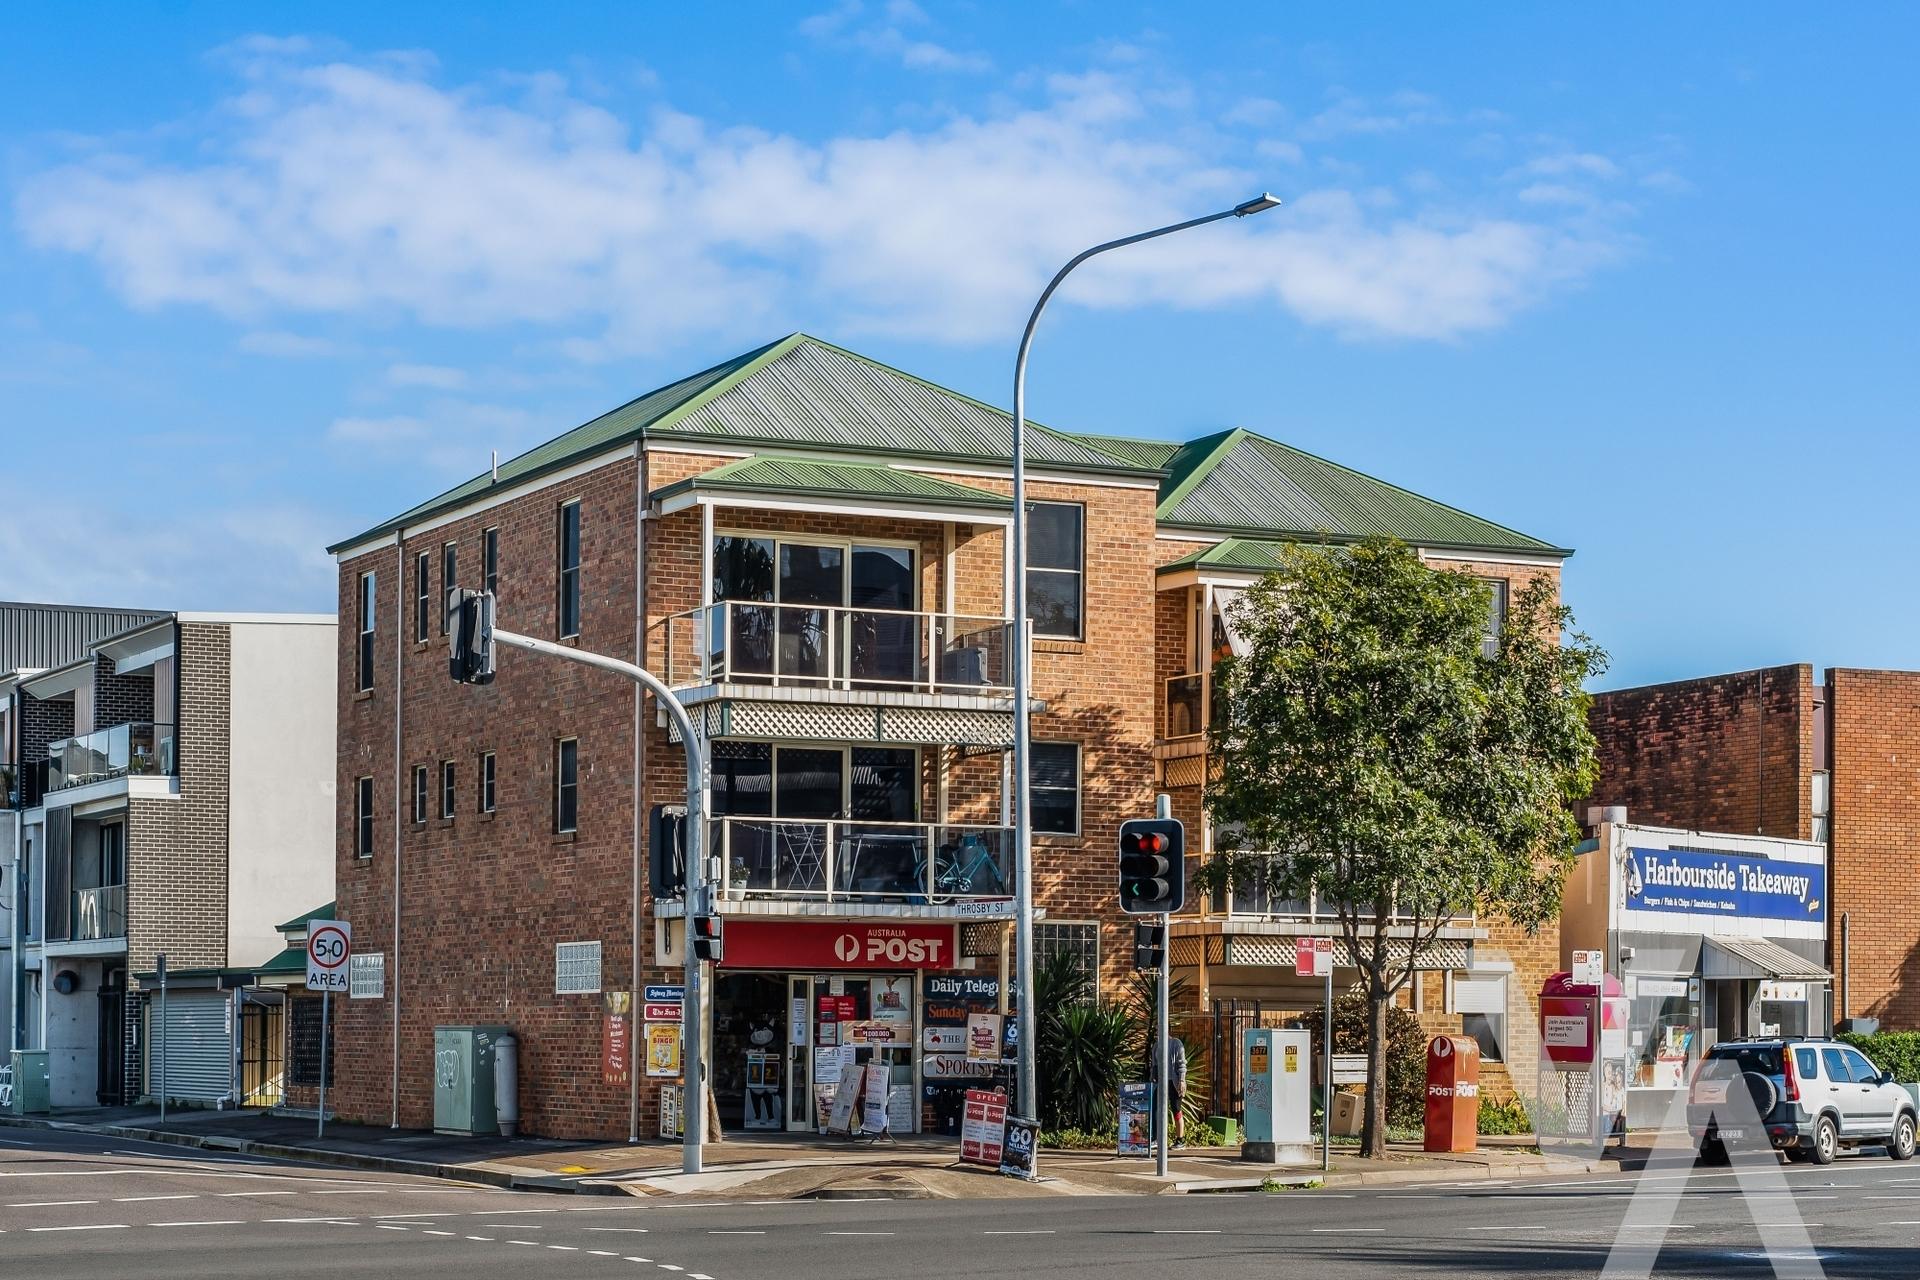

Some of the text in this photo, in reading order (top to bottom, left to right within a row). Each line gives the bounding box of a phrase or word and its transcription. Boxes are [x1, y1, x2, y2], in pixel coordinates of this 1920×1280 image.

[1644, 856, 1809, 903] Harbourside Takeaway
[1644, 895, 1660, 906] Burgers
[1678, 898, 1690, 909] Chips
[1693, 899, 1717, 909] Sandwiches
[957, 903, 1004, 914] THROSBY ST
[867, 929, 906, 937] AUSTRALIA
[316, 939, 343, 957] 50
[867, 937, 943, 962] POST
[309, 973, 346, 986] AREA
[650, 989, 666, 998] Sydney
[931, 979, 962, 996] Daily
[653, 1008, 664, 1016] The
[928, 1004, 967, 1020] Sunday
[943, 1035, 960, 1044] THE
[1429, 1087, 1454, 1097] POST
[1456, 1084, 1477, 1097] POST
[976, 1094, 998, 1102] OPEN
[1009, 1142, 1030, 1151] MILLION
